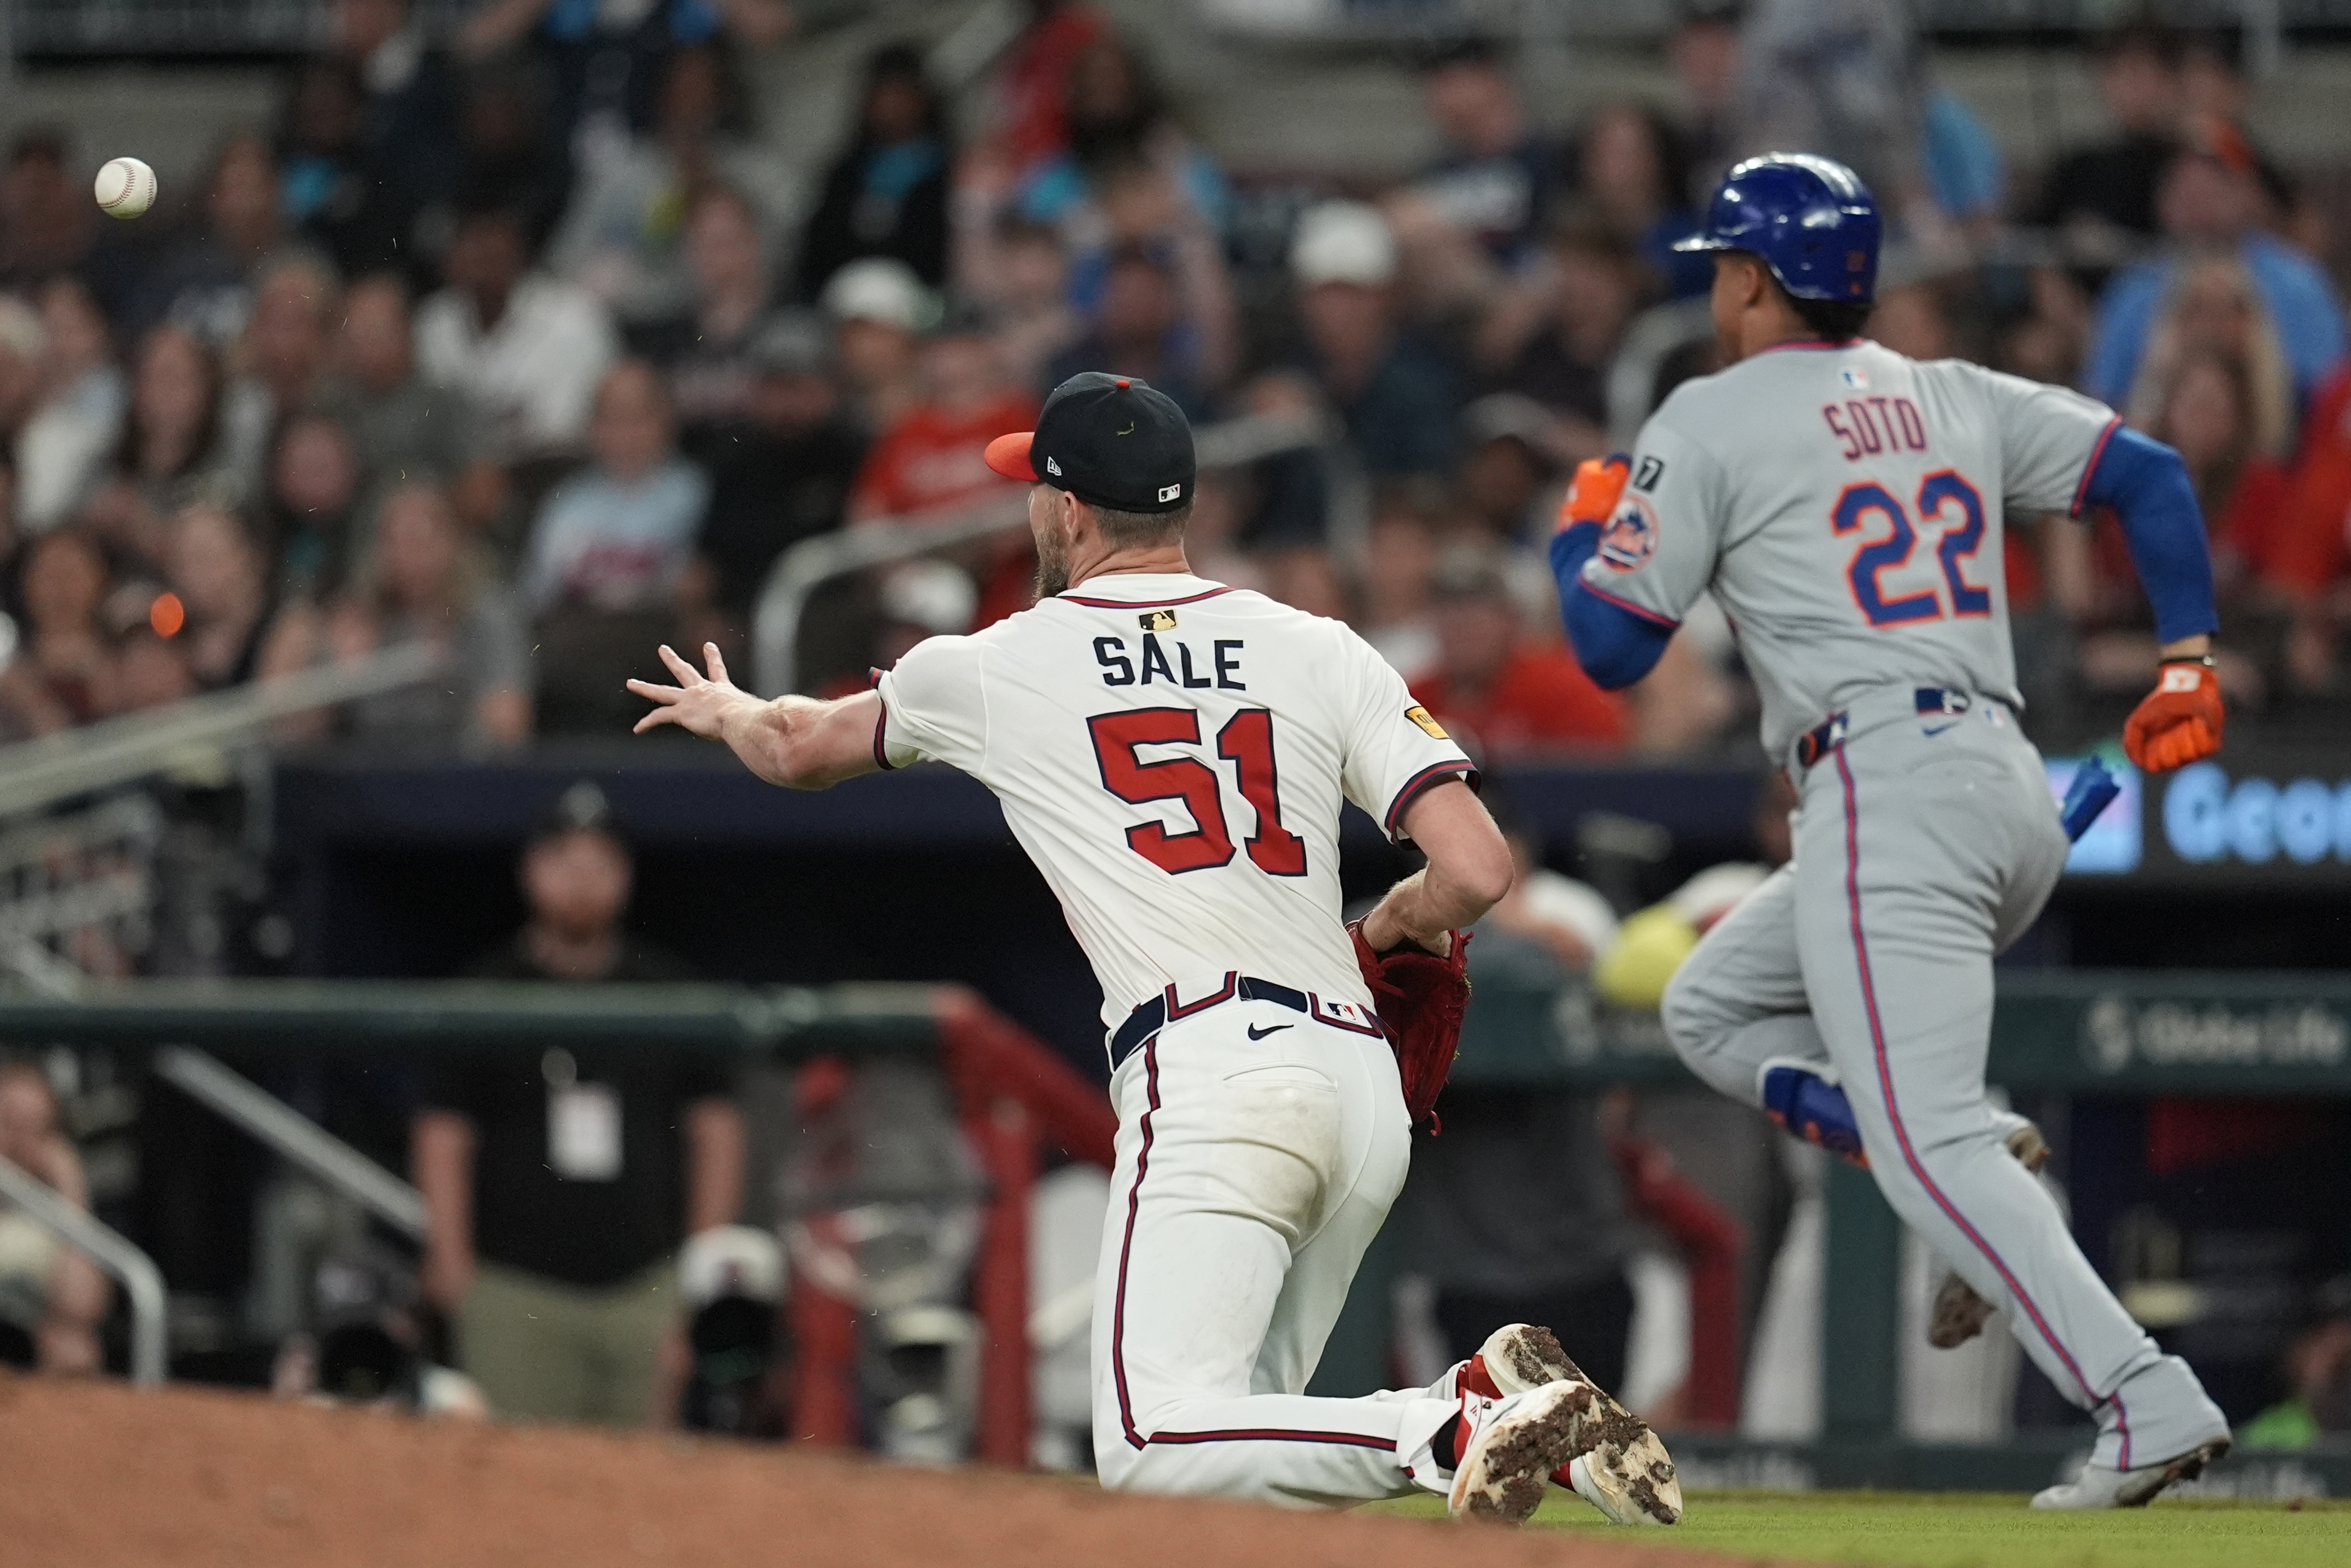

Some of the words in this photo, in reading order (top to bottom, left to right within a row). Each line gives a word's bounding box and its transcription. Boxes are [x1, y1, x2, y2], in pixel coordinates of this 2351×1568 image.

[1822, 396, 1927, 461] SOTO
[1829, 468, 1992, 630] 22
[1093, 633, 1246, 691] SALE
[1086, 707, 1308, 877] 51
